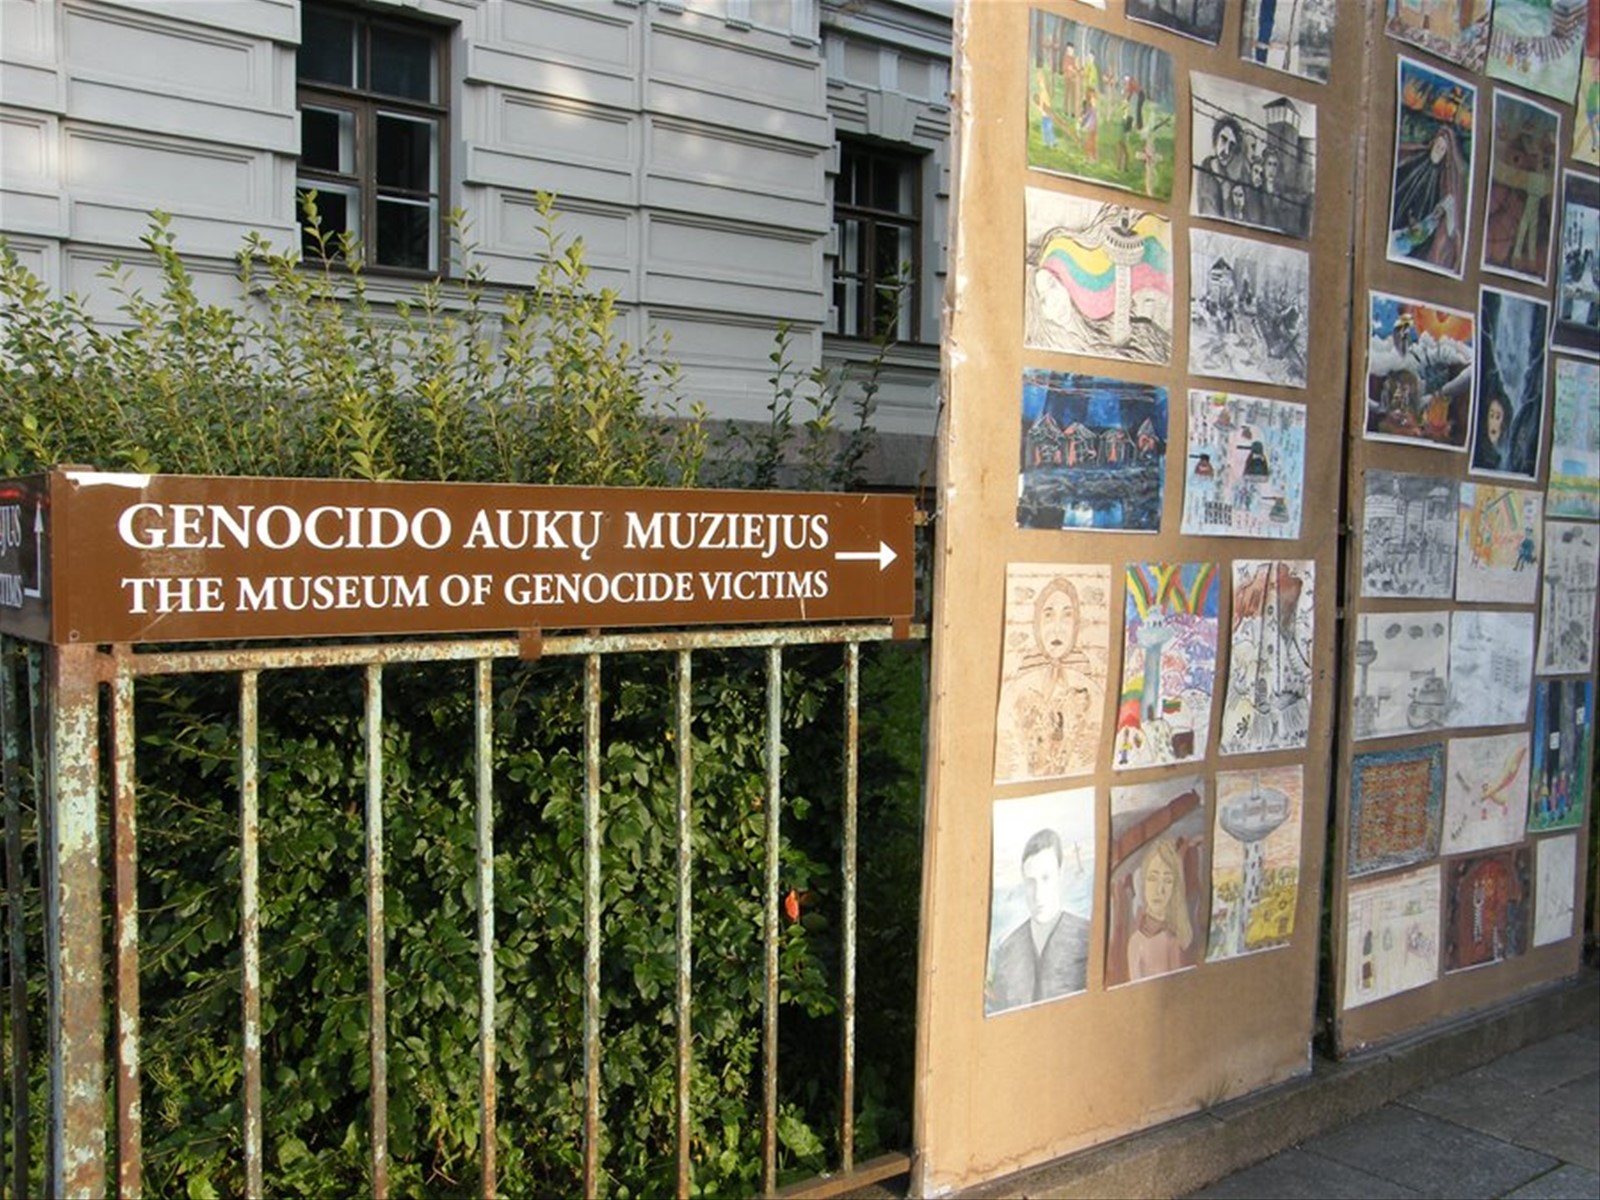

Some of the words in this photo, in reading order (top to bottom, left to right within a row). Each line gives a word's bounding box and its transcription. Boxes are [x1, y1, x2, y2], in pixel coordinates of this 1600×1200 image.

[117, 502, 452, 550] GENOCIDO
[462, 508, 604, 561] AUKŲ
[623, 511, 829, 558] MUZIEJUS
[121, 577, 225, 614] THE
[235, 574, 430, 611] MUSEUM
[439, 574, 493, 607] OF
[503, 572, 694, 606] GENOCIDE
[699, 570, 829, 600] VICTIMS
